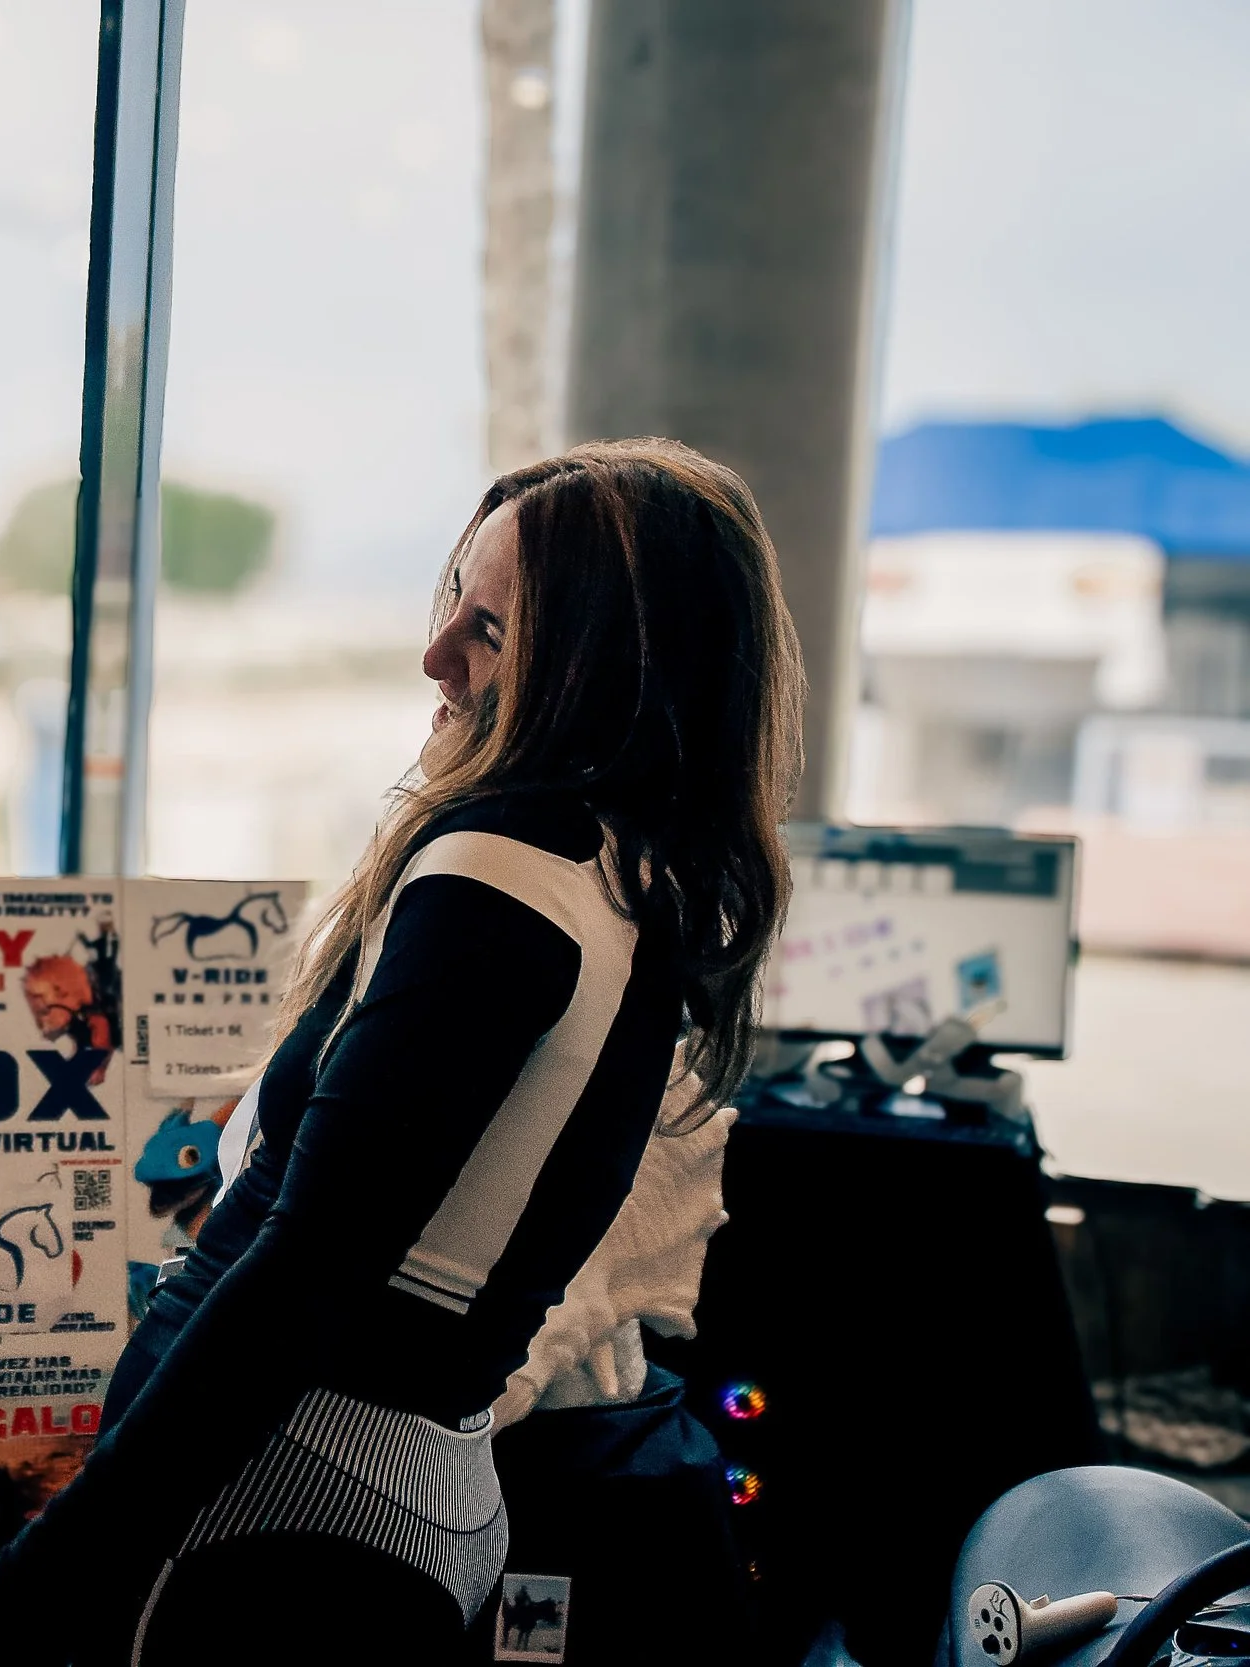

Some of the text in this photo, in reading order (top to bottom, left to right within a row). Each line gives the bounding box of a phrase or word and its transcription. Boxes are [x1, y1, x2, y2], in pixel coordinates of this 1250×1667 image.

[91, 893, 113, 904] TO
[5, 905, 91, 917] REALITY?
[172, 968, 267, 985] V-RIDE
[175, 1024, 214, 1037] Ticket
[165, 1063, 173, 1075] 2
[176, 1063, 222, 1075] Tickets
[34, 1356, 72, 1369] HAS
